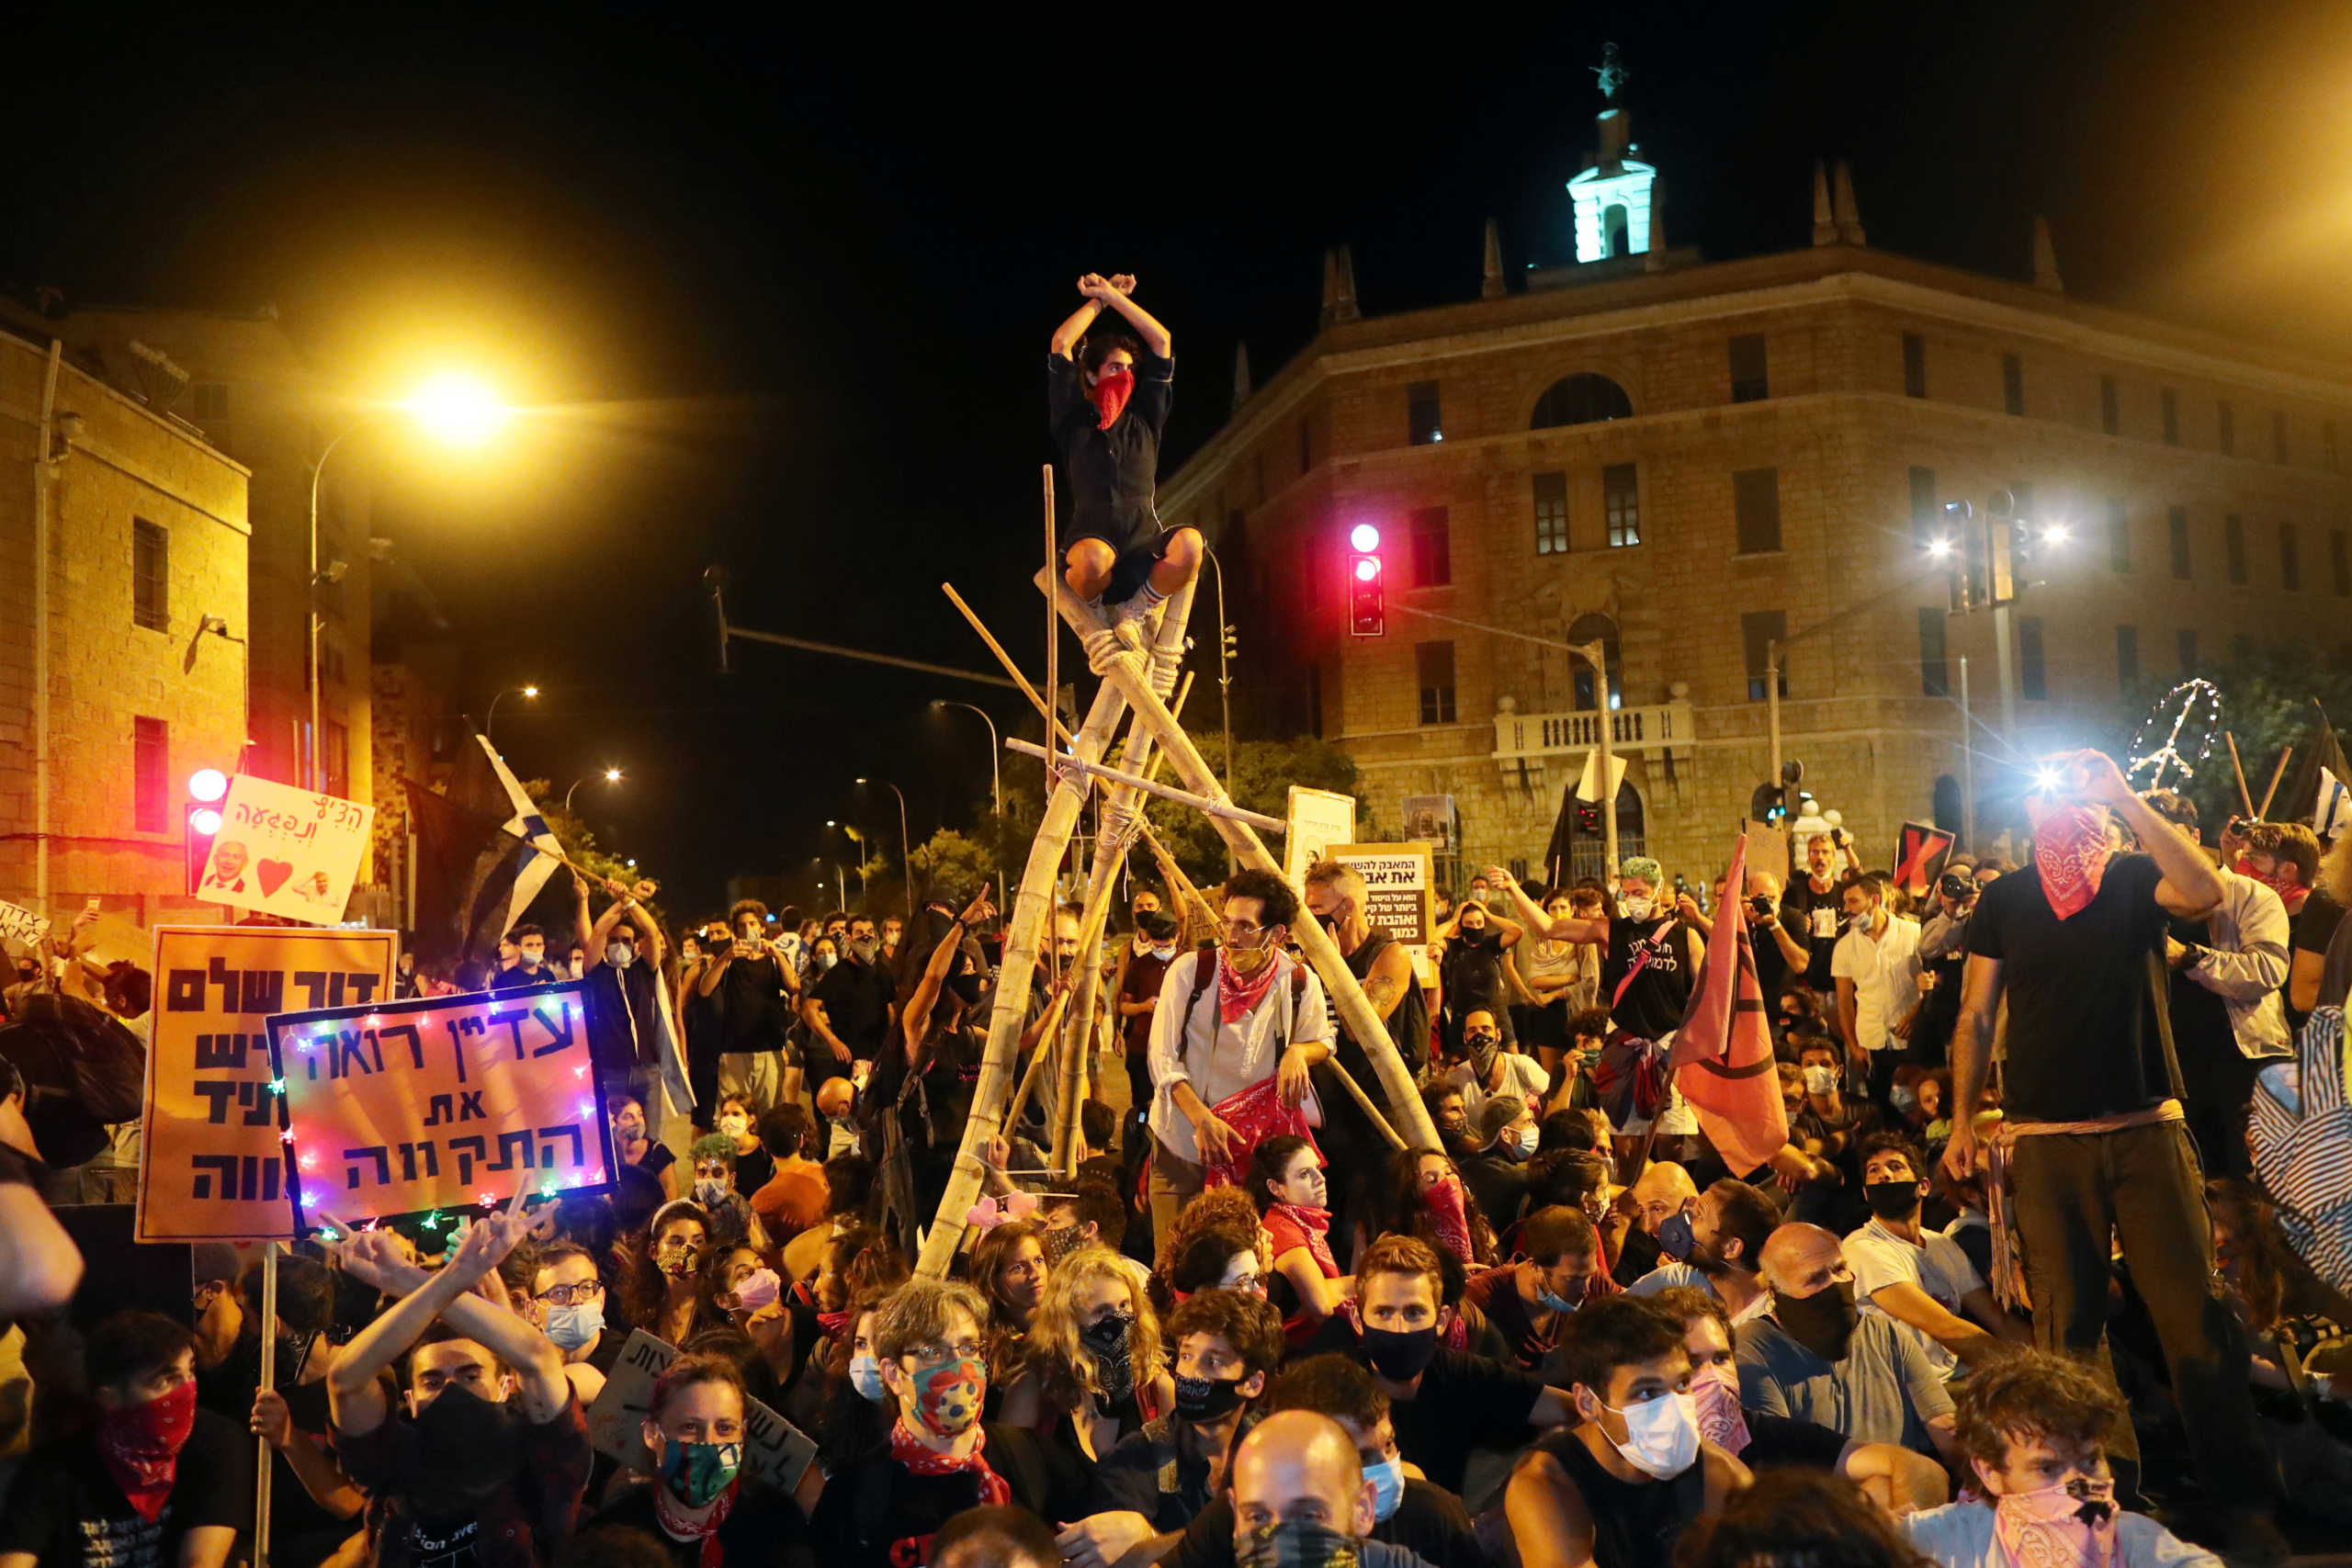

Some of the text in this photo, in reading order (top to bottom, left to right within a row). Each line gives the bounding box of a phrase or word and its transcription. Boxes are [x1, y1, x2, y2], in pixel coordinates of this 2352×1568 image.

[1391, 872, 1415, 883] את
[1377, 914, 1417, 926] ואהבת
[1379, 903, 1392, 911] של
[1389, 928, 1418, 941] כמוך
[167, 957, 379, 1013] דור שלם
[305, 1001, 574, 1083] עדיין רואה
[194, 1080, 281, 1126] תיד
[424, 1090, 487, 1126] את
[344, 1124, 585, 1189] התקווה
